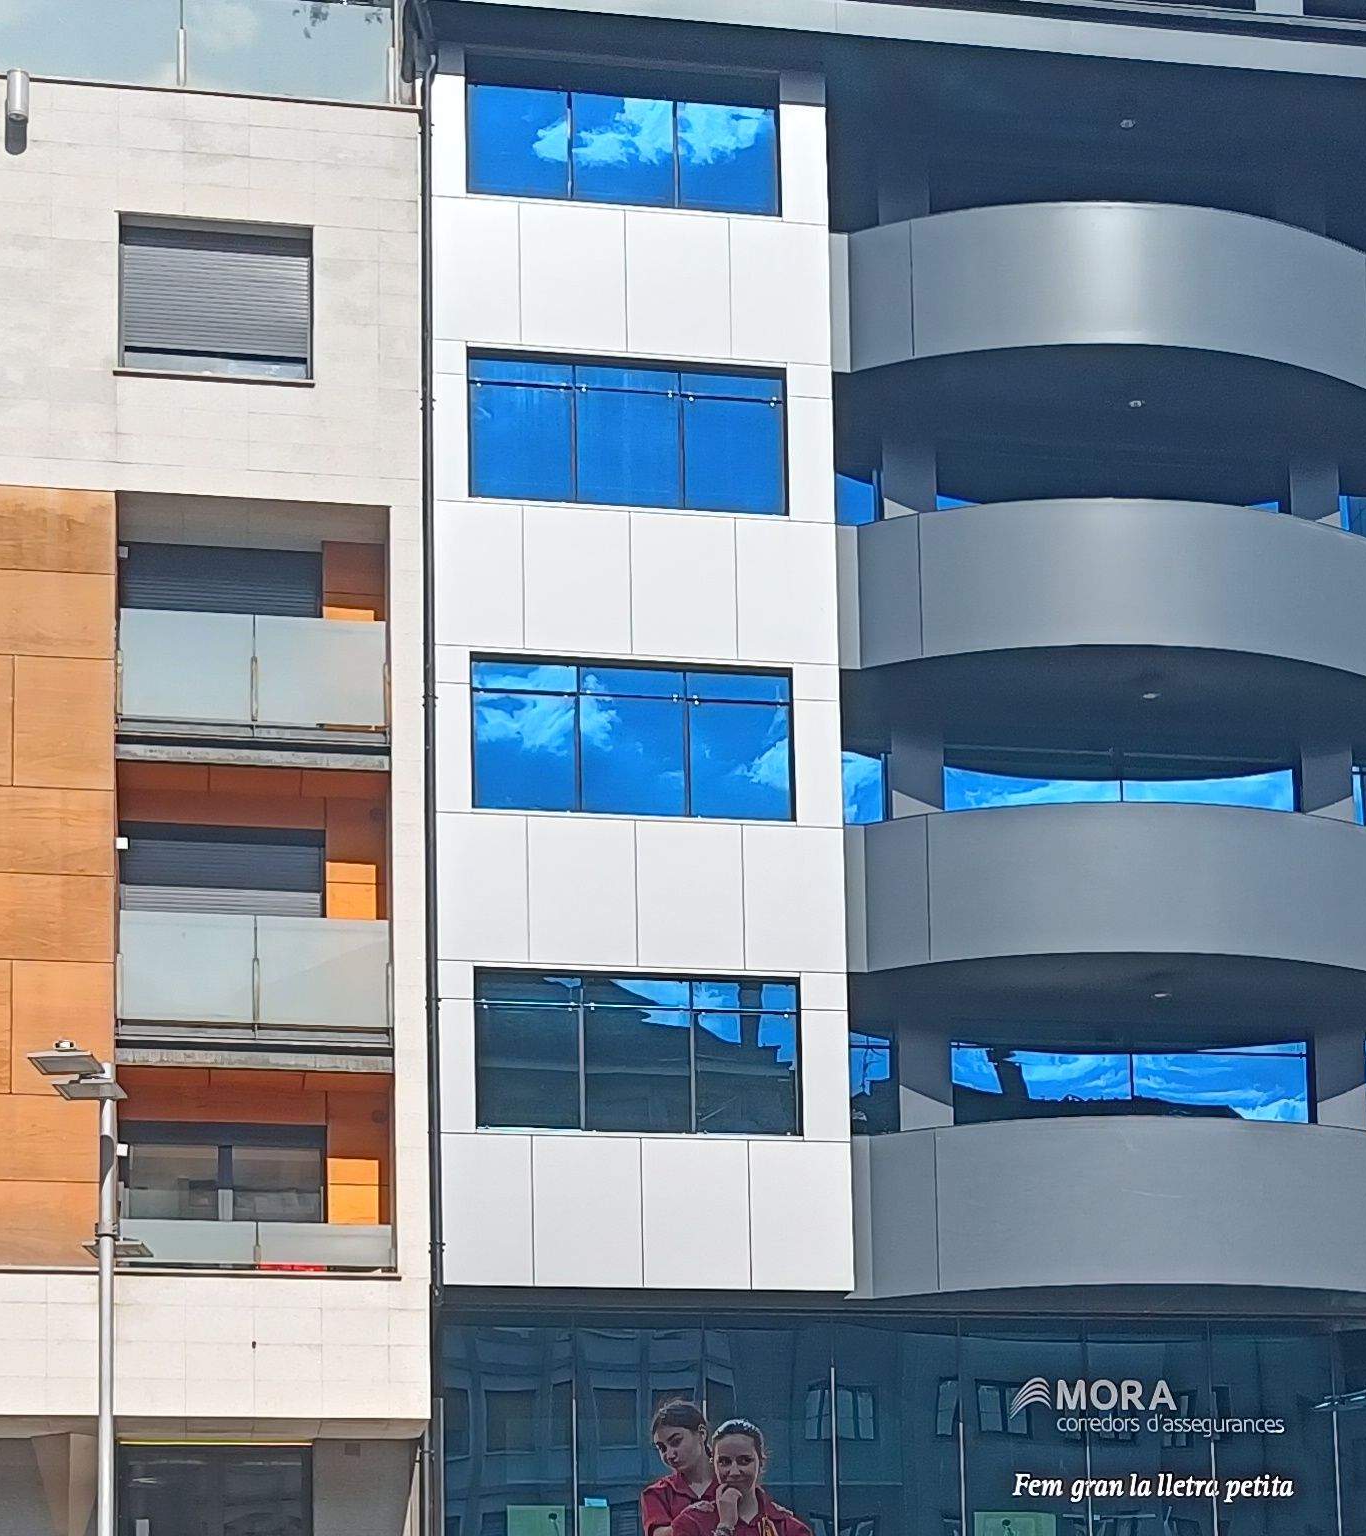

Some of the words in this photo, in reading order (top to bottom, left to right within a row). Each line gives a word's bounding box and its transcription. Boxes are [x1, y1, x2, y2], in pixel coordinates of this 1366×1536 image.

[1056, 1379, 1178, 1411] MORA
[1056, 1414, 1140, 1433] corredors
[1147, 1414, 1286, 1437] d'assegurances
[1012, 1473, 1064, 1497] Fem
[1070, 1477, 1125, 1503] gran
[1129, 1473, 1152, 1497] la
[1157, 1473, 1219, 1497] lletra
[1223, 1475, 1295, 1503] petita
